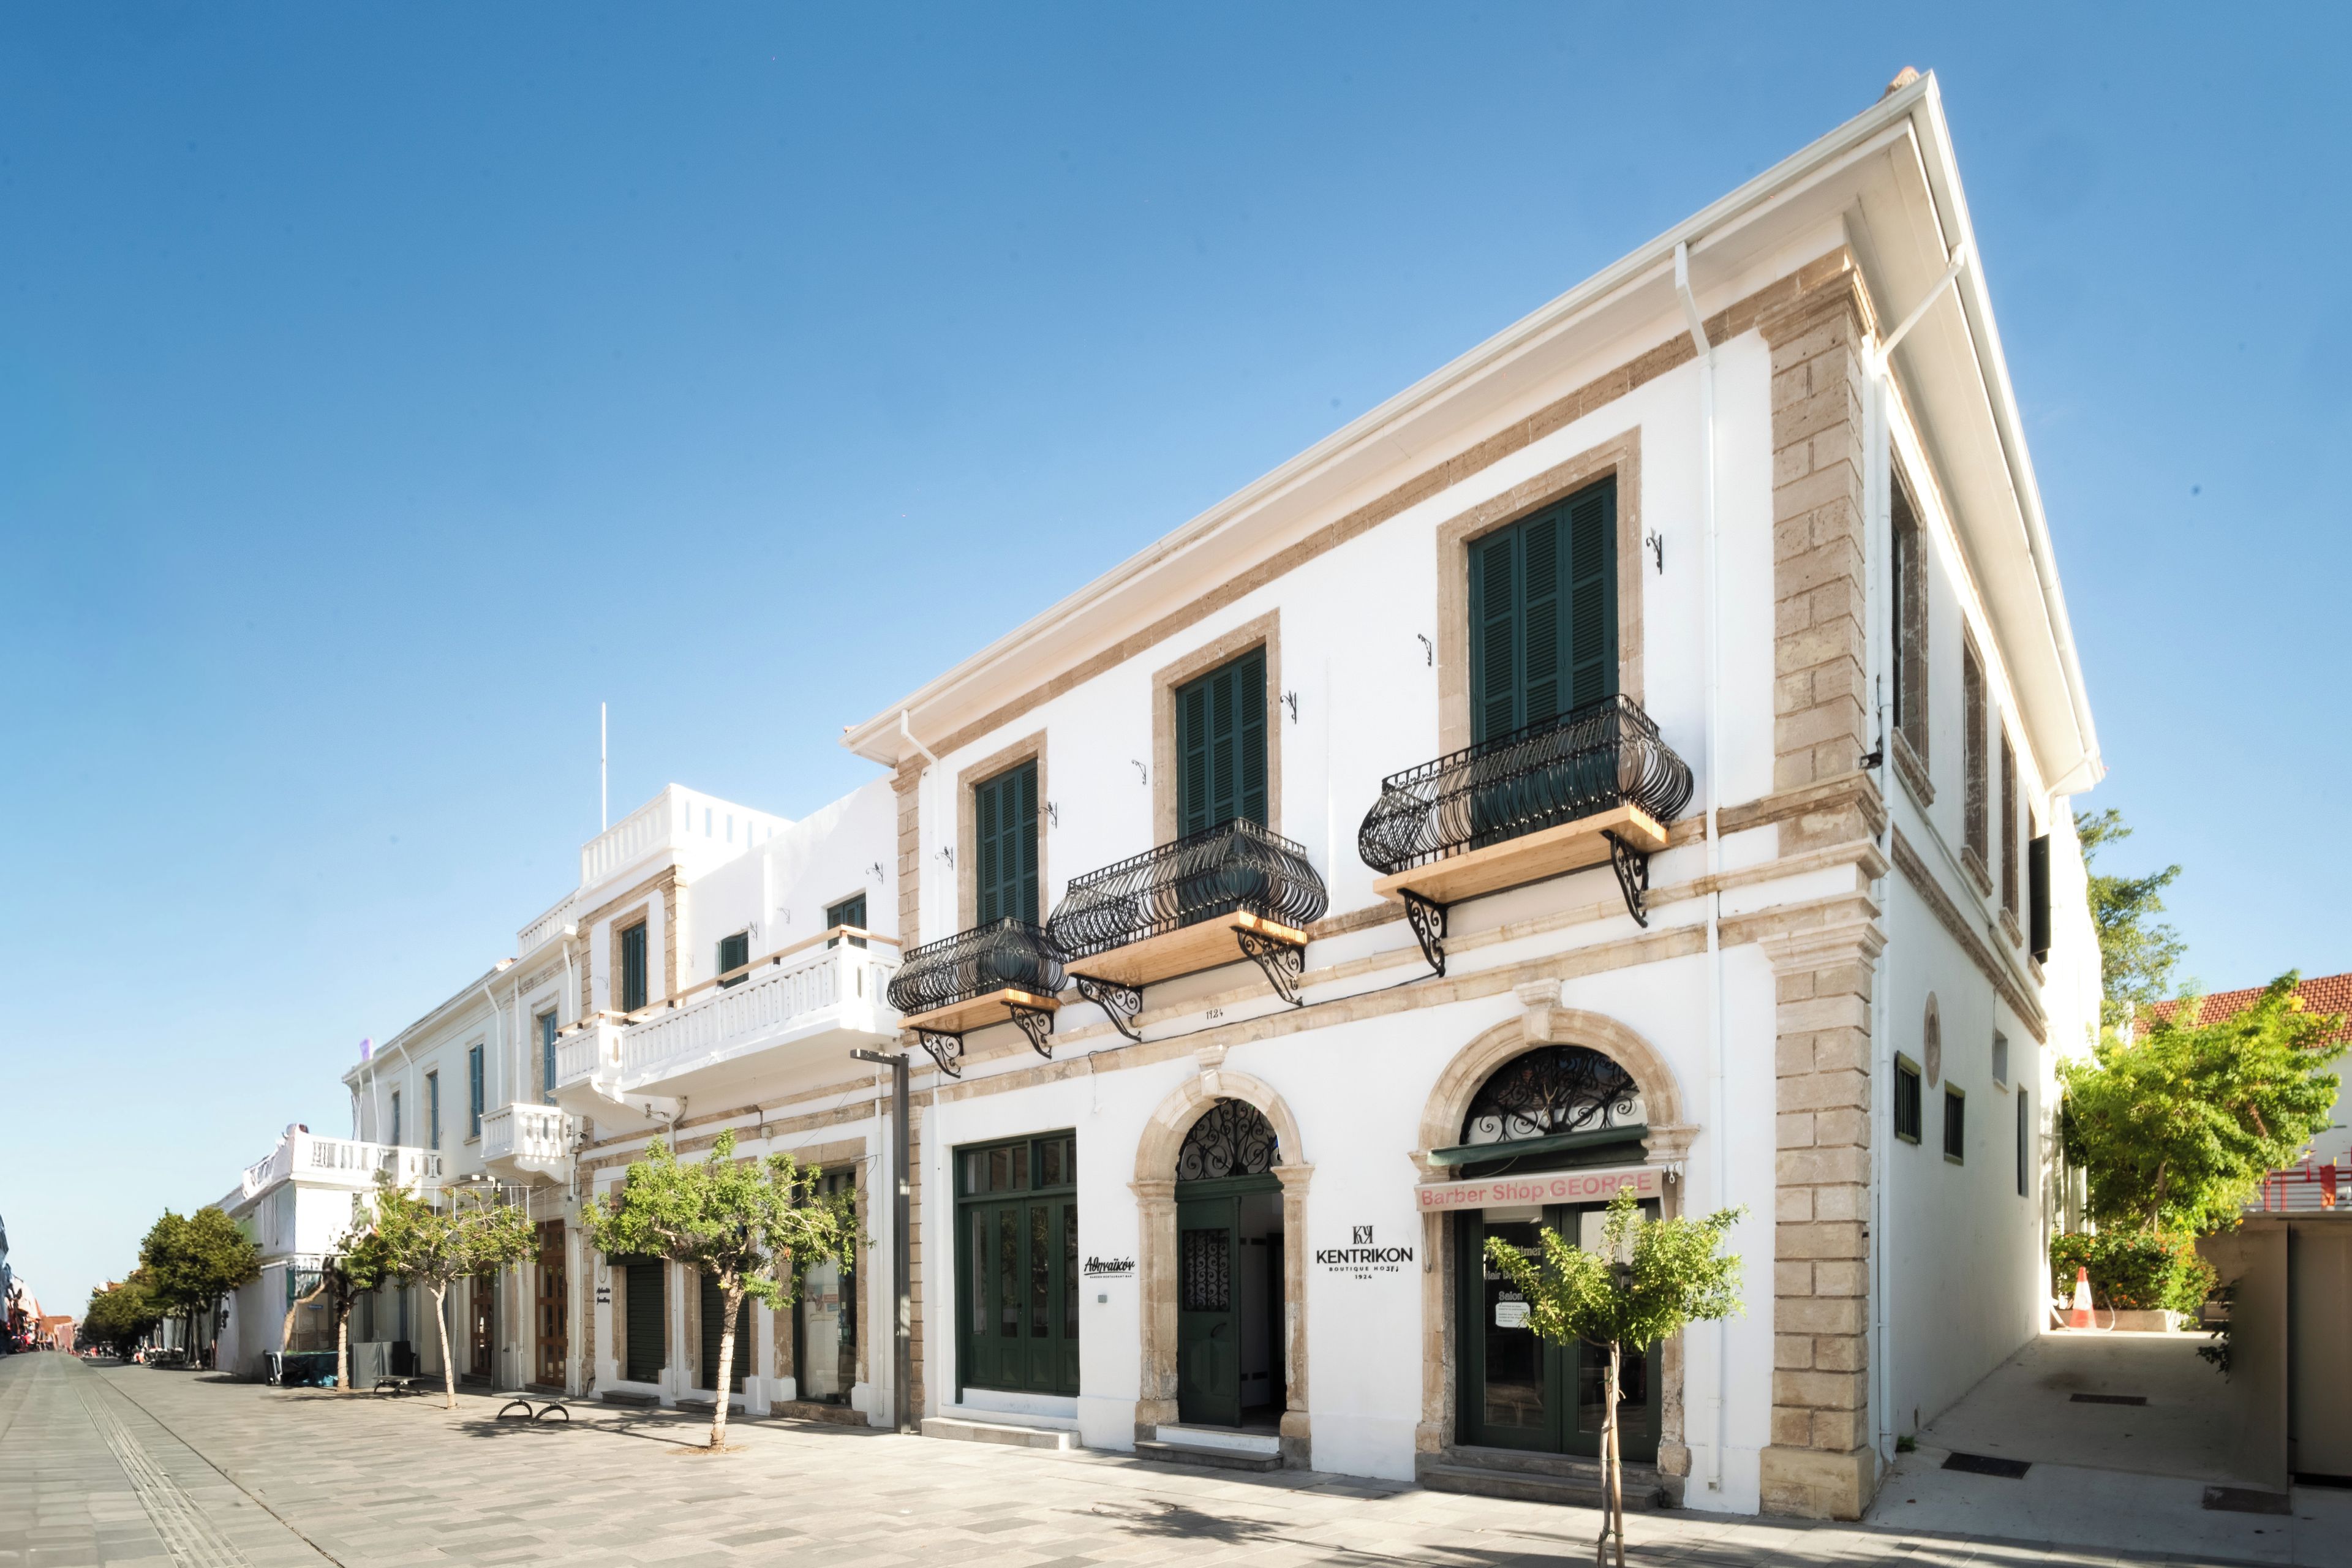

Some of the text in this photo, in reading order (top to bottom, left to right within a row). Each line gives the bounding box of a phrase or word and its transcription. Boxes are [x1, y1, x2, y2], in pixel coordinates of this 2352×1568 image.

[1205, 1008, 1224, 1020] 1924
[1422, 1172, 1653, 1206] Barber Shop GEORGE
[1316, 1247, 1413, 1264] KENTRIKON
[1499, 1291, 1523, 1300] Salon
